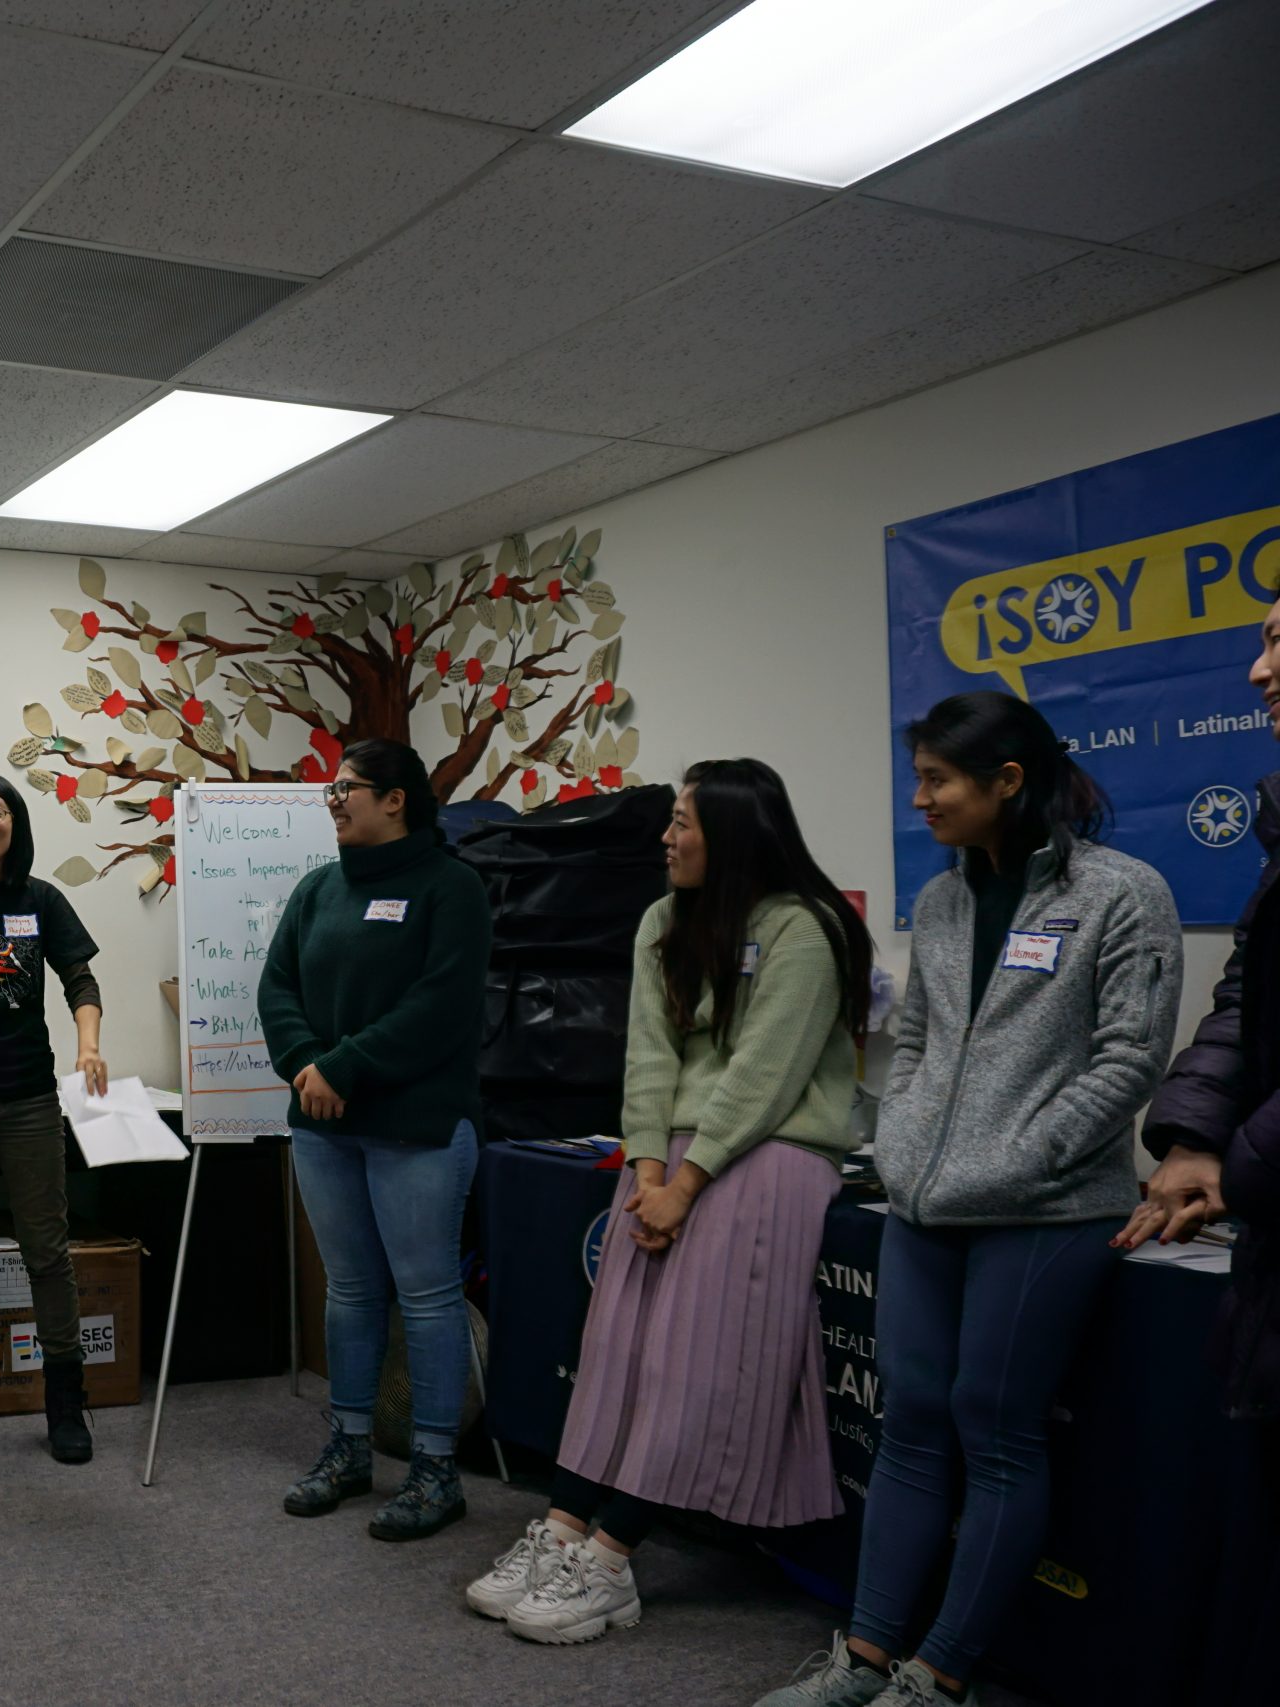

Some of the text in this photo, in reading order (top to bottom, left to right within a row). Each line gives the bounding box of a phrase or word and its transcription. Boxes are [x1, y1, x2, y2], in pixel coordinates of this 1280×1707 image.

[201, 810, 291, 844] Welcome!
[201, 858, 237, 879] Issues
[196, 937, 233, 960] Take
[197, 977, 250, 1001] What's
[81, 1326, 113, 1343] SEC
